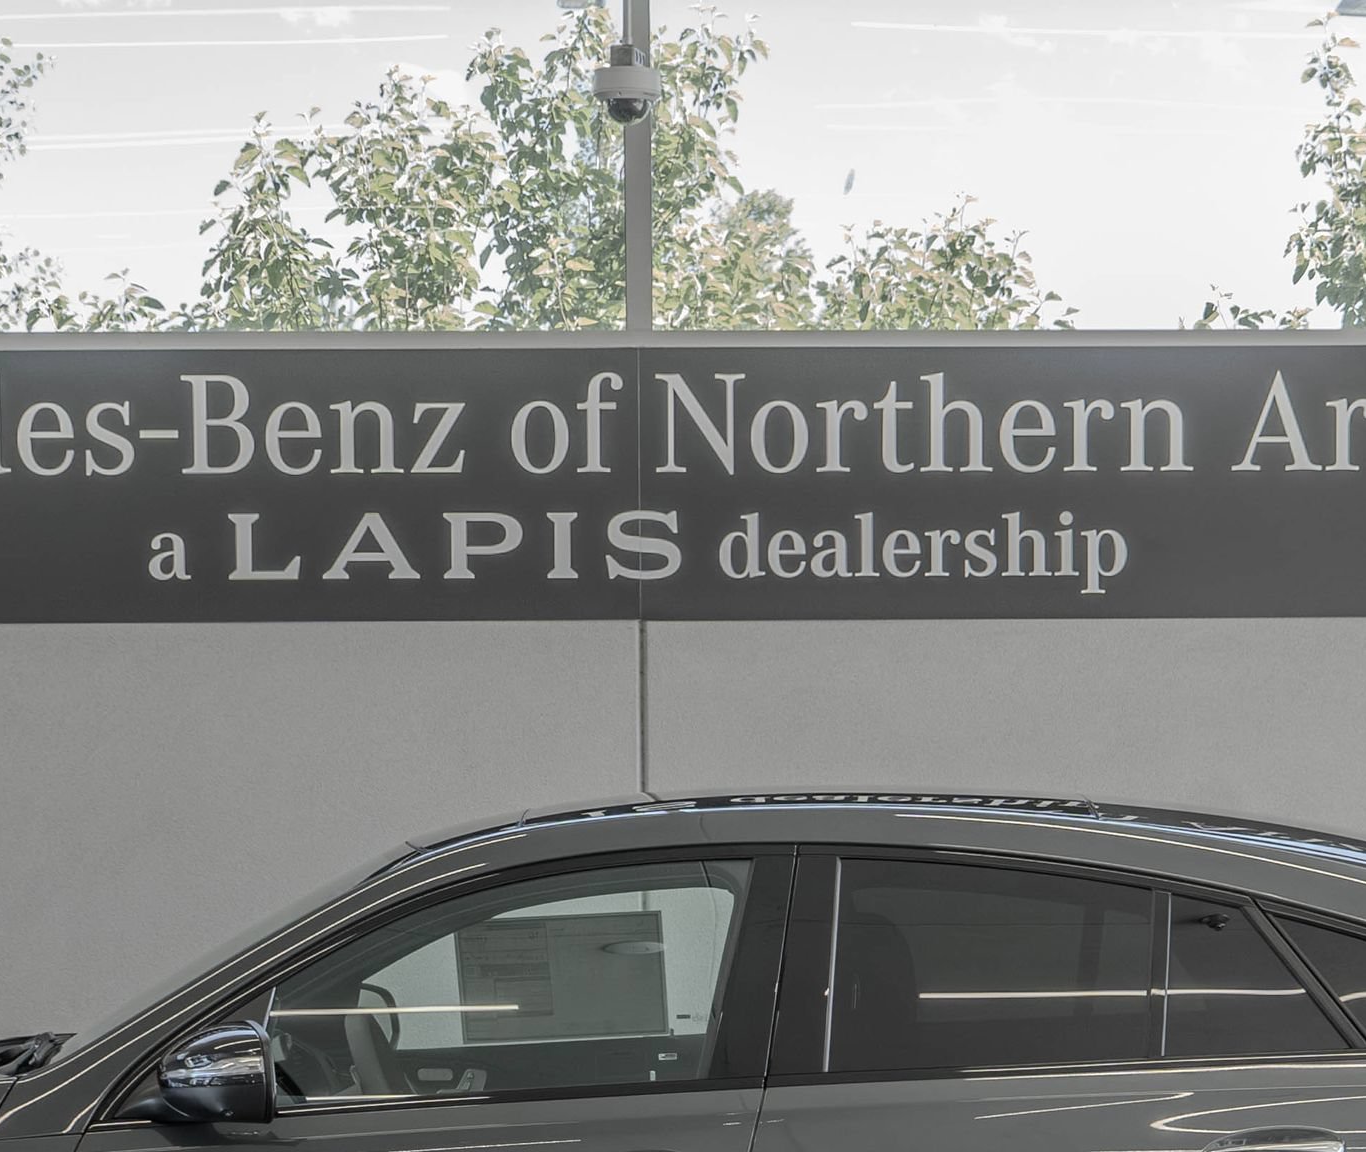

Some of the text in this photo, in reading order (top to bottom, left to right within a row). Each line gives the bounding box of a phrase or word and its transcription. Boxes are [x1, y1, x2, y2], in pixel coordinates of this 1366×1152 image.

[509, 370, 625, 476] of
[653, 370, 1196, 477] Northern
[147, 508, 1129, 596] a LAPIS dealership
